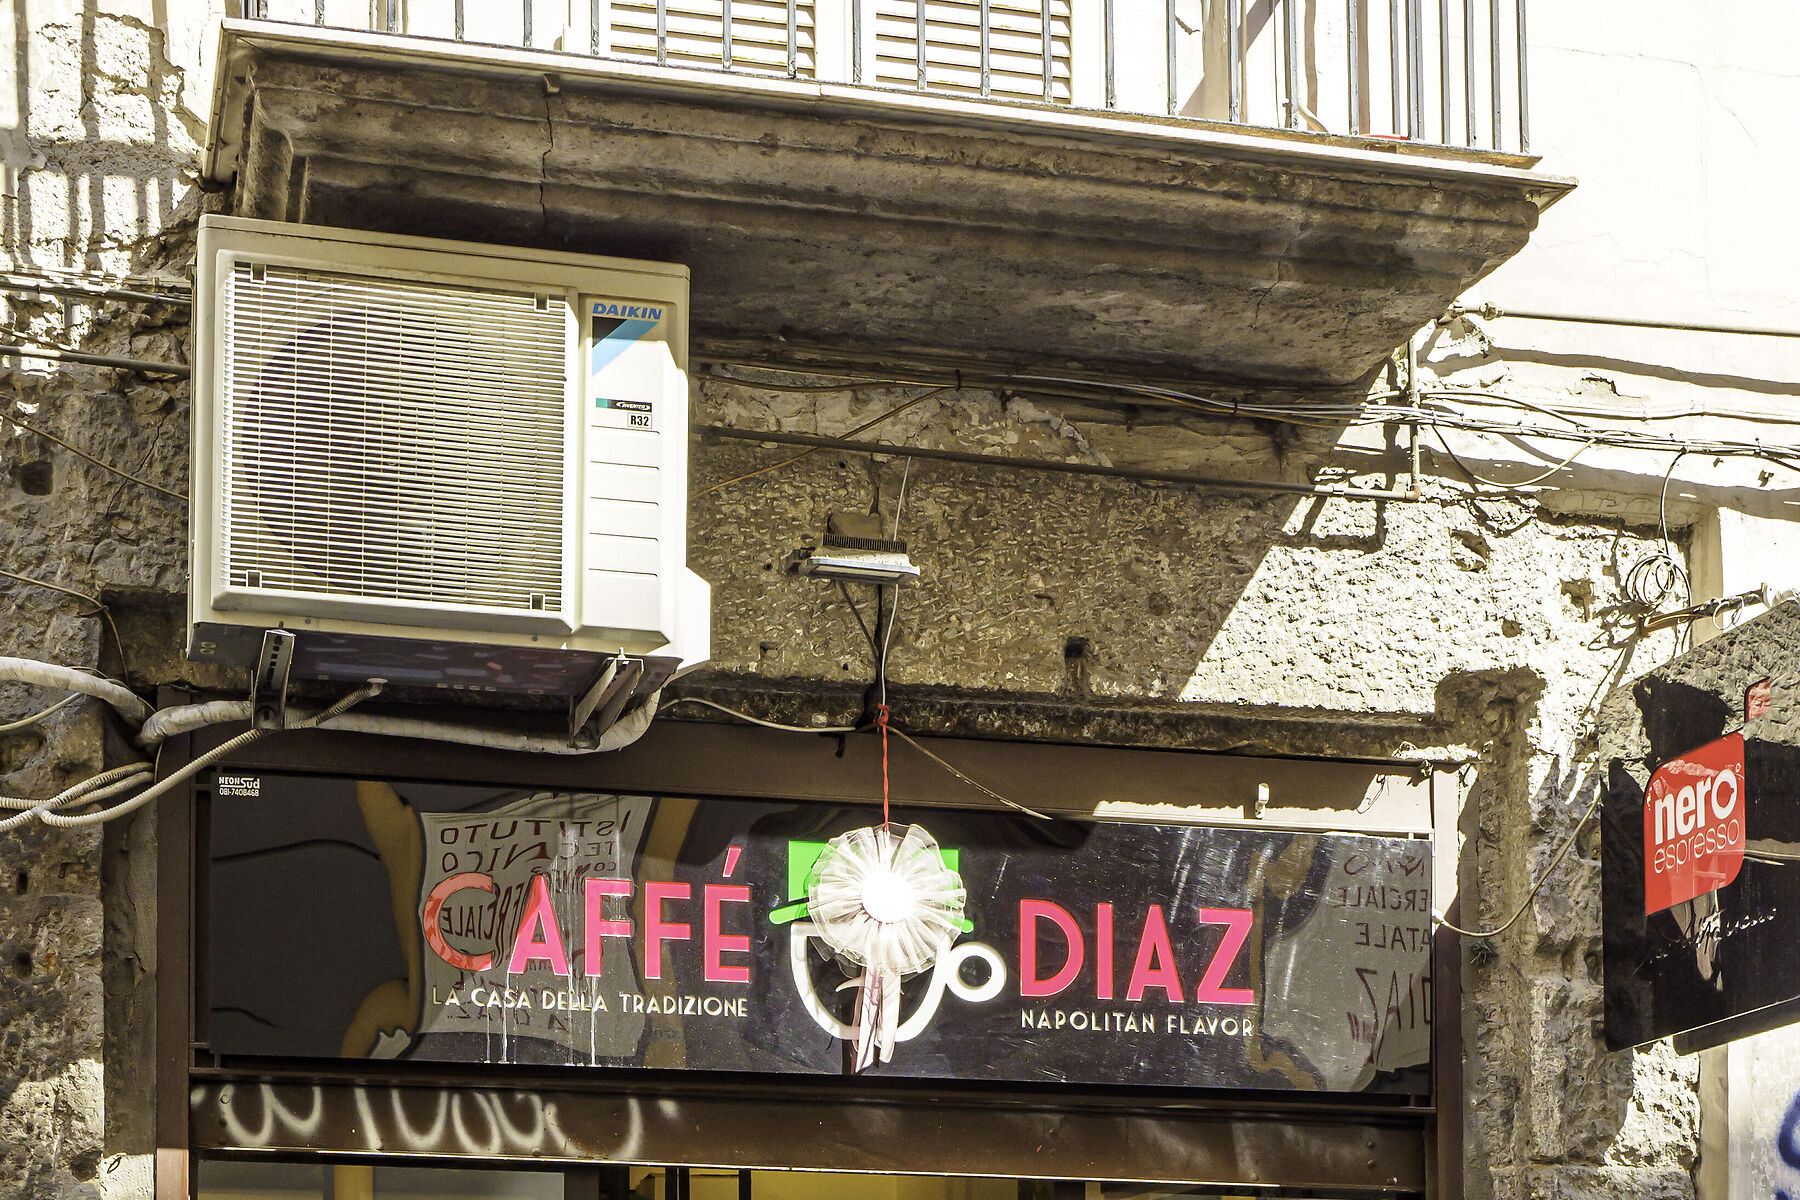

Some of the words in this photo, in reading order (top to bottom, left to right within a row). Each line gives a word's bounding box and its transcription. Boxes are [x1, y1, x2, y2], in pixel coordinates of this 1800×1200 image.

[592, 303, 662, 320] DAIKIN
[630, 415, 649, 427] R32
[1655, 768, 1738, 846] nero
[1654, 818, 1740, 874] espresso
[423, 846, 750, 984] CAFFÉ
[1020, 899, 1255, 1005] DIAZ
[432, 984, 461, 1007] LA
[470, 987, 532, 1010] CASA
[541, 988, 609, 1013] DELLA
[619, 991, 748, 1018] TRADIZIONE
[1020, 1008, 1155, 1034] NAPOLITAN
[1166, 1014, 1254, 1037] FLAVOR
